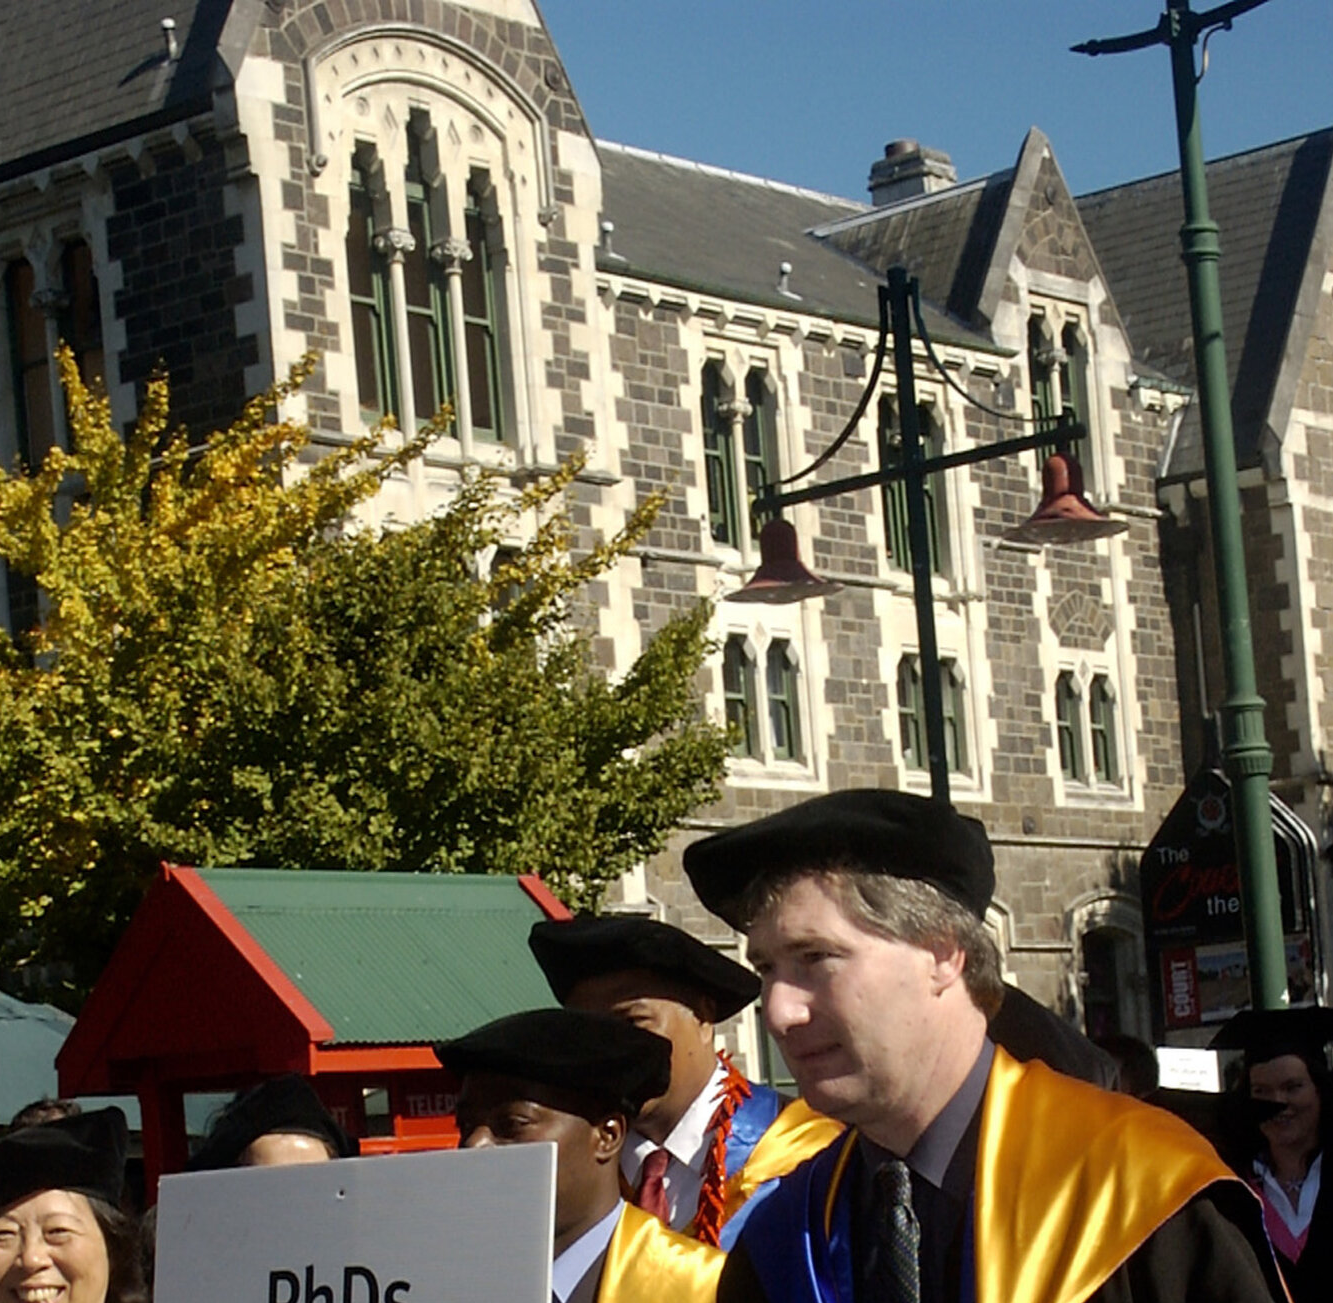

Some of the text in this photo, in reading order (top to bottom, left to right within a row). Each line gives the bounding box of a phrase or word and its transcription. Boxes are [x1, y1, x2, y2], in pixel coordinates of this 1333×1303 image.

[1157, 847, 1189, 864] The
[1207, 896, 1240, 916] the
[406, 1093, 459, 1117] TELEP
